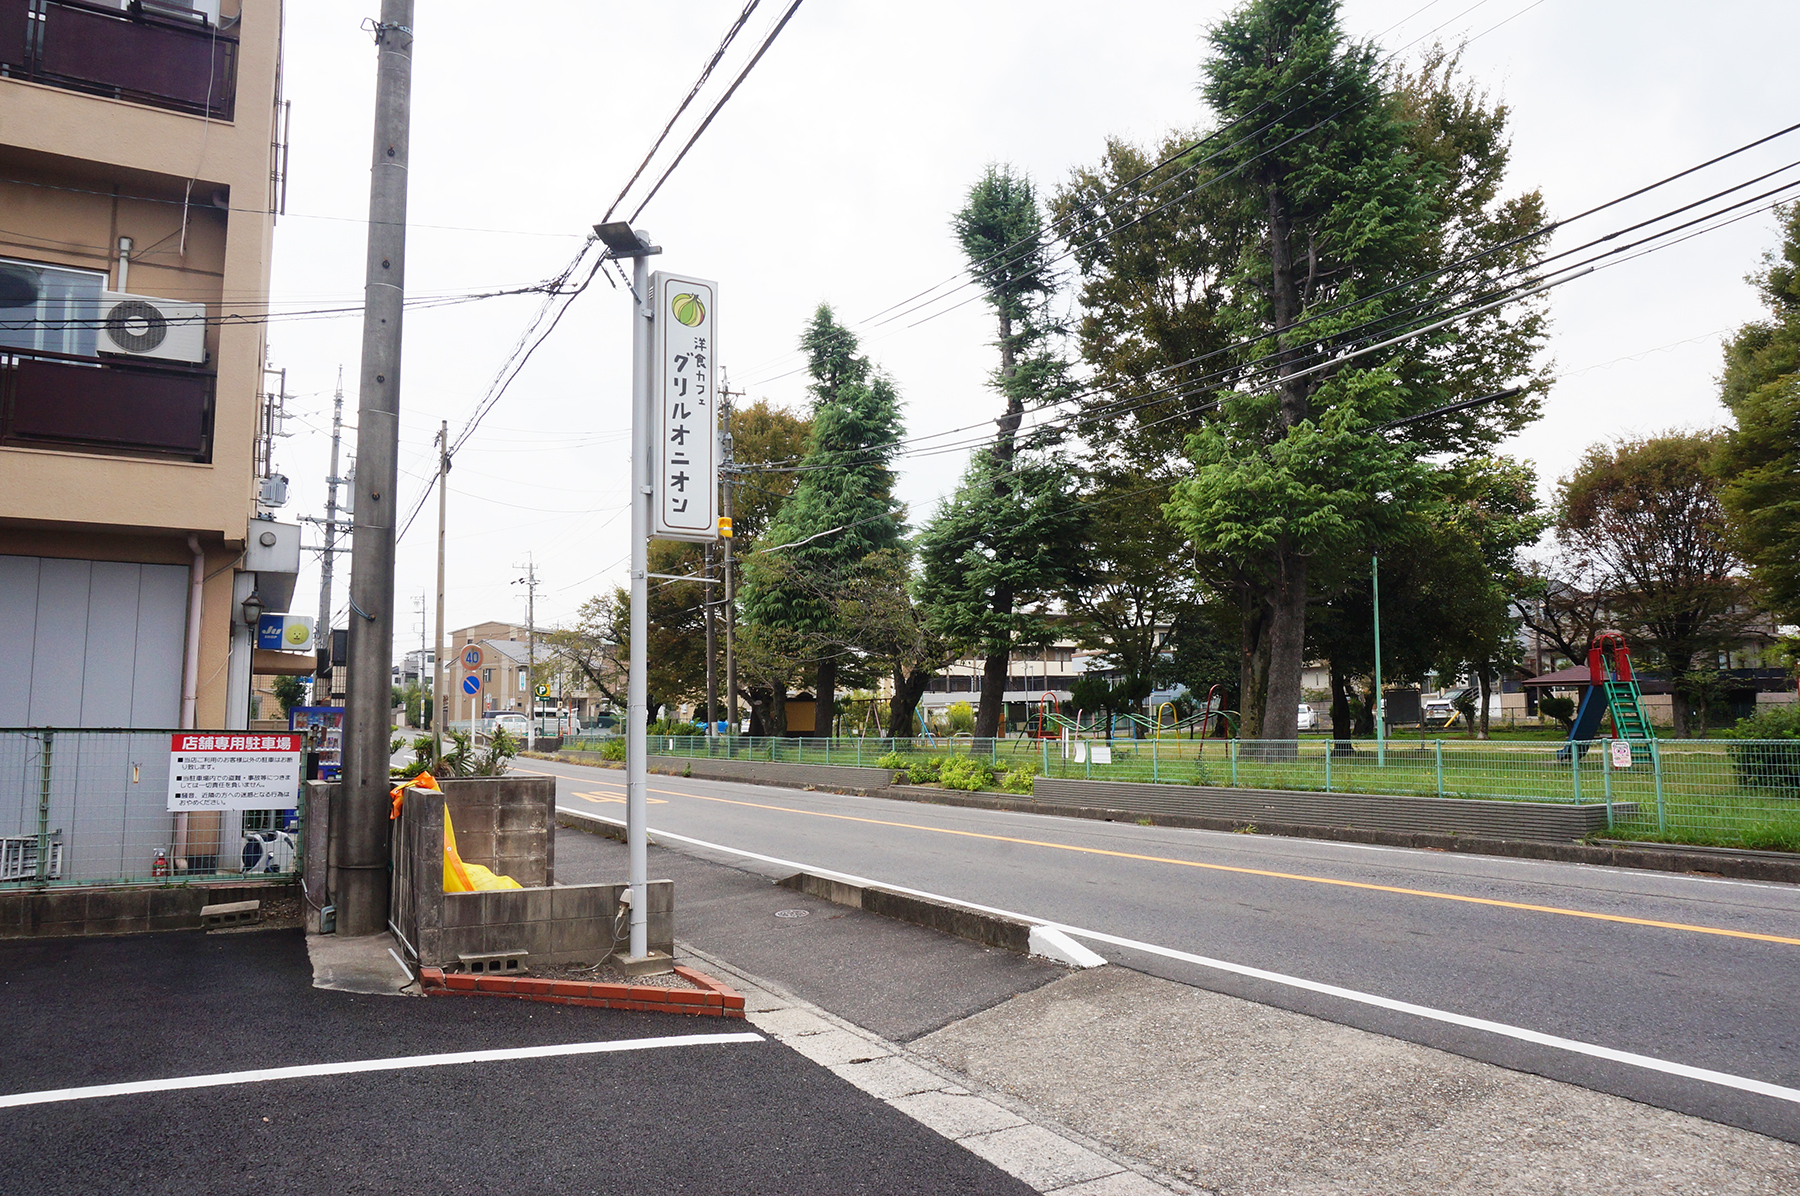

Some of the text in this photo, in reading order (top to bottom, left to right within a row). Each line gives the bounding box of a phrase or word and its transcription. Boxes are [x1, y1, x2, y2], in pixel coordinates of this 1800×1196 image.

[694, 337, 706, 405] 洋食カフェ
[671, 353, 693, 512] グリルオニオン
[466, 652, 479, 663] 40
[539, 686, 546, 695] P
[182, 736, 291, 750] 店舗専用駐車場
